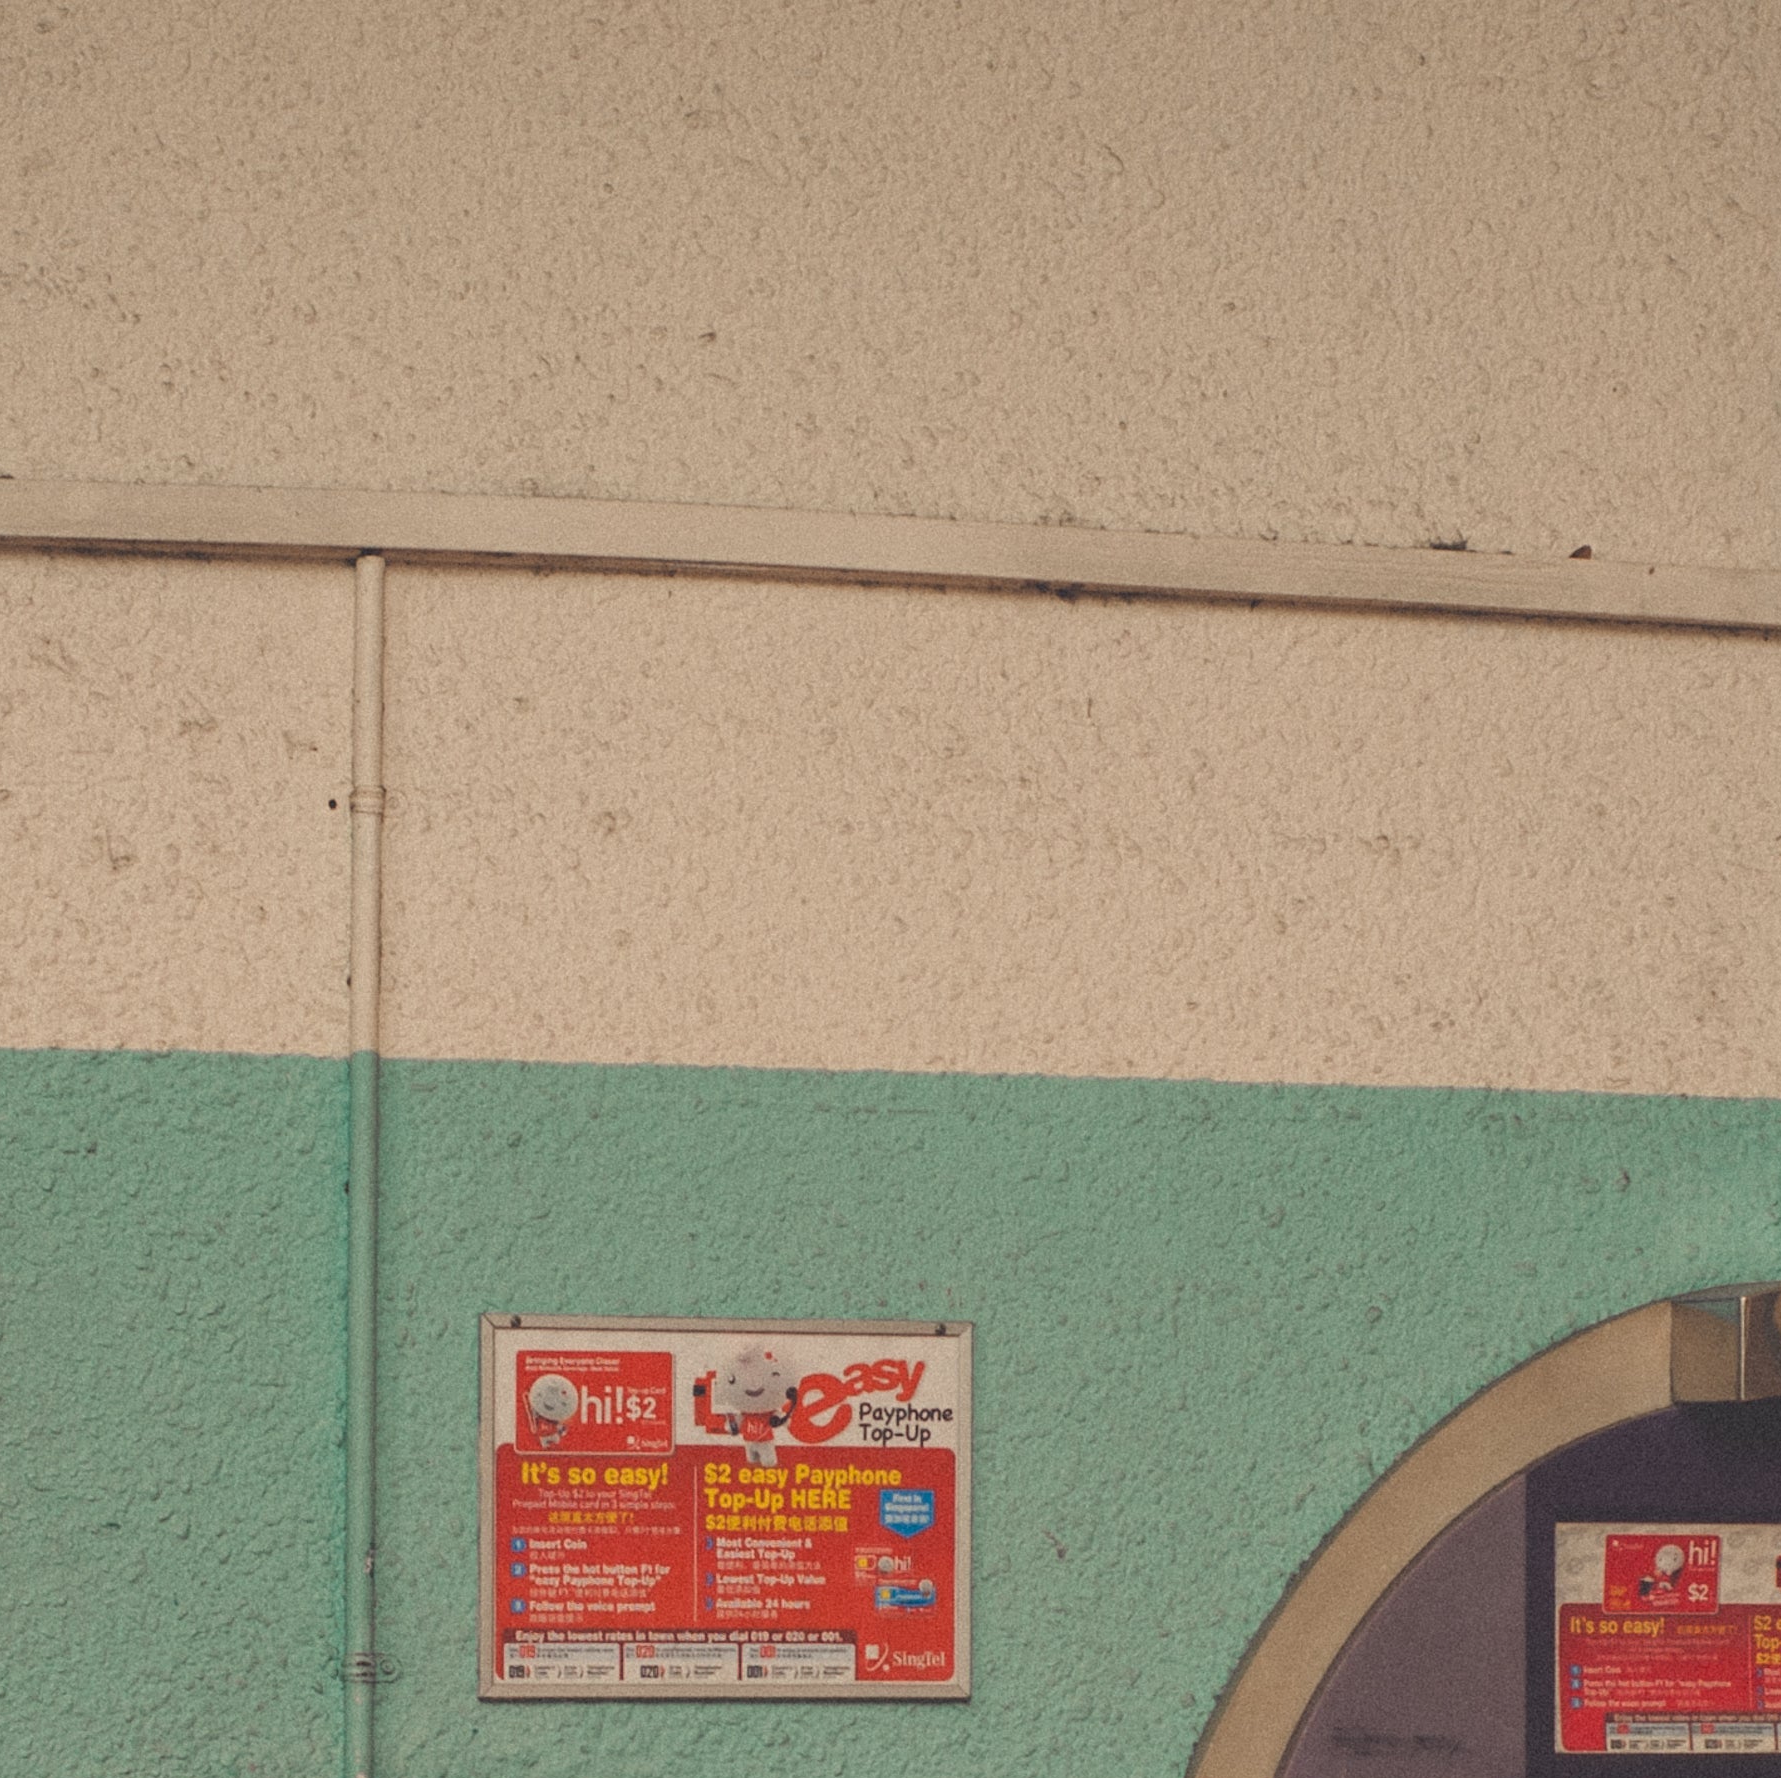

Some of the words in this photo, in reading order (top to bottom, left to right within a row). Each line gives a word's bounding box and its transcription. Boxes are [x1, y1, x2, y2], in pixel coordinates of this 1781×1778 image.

[580, 1384, 624, 1425] hi!
[625, 1394, 657, 1422] $2
[786, 1358, 926, 1444] easy
[859, 1402, 953, 1427] Payphone
[859, 1423, 931, 1448] Top-Up
[522, 1461, 561, 1485] It's
[568, 1466, 596, 1485] so
[604, 1462, 668, 1491] easy!
[704, 1463, 731, 1485] $2
[738, 1466, 789, 1489] easy
[795, 1464, 902, 1489] Payphone
[704, 1488, 784, 1513] Top-Up
[791, 1488, 851, 1510] HERE
[529, 1539, 561, 1550] Insert
[564, 1538, 588, 1549] Coin
[716, 1537, 742, 1548] Most
[744, 1537, 803, 1549] Convenient
[716, 1549, 755, 1559] Easiest
[757, 1549, 796, 1560] Top-Up
[1687, 1539, 1717, 1566] hi!
[894, 1556, 912, 1571] hi!
[716, 1574, 754, 1584] Lowest
[756, 1574, 795, 1586] Top-Up
[797, 1574, 826, 1585] Value
[716, 1599, 763, 1609] Available
[781, 1599, 810, 1609] hours
[1688, 1582, 1709, 1603] $2
[515, 1630, 545, 1642] Enjoy
[547, 1630, 565, 1641] the
[567, 1630, 604, 1641] lowest
[605, 1630, 634, 1641] rates
[635, 1630, 646, 1641] in
[648, 1631, 675, 1641] town
[677, 1631, 706, 1641] when
[707, 1632, 727, 1643] you
[728, 1631, 749, 1641] dial
[750, 1631, 770, 1642] 019
[771, 1632, 783, 1642] or
[785, 1631, 806, 1642] 020
[807, 1632, 820, 1642] or
[1570, 1615, 1595, 1634] It's
[1599, 1619, 1619, 1634] so
[1623, 1617, 1666, 1639] easy!
[892, 1651, 946, 1669] SingTel
